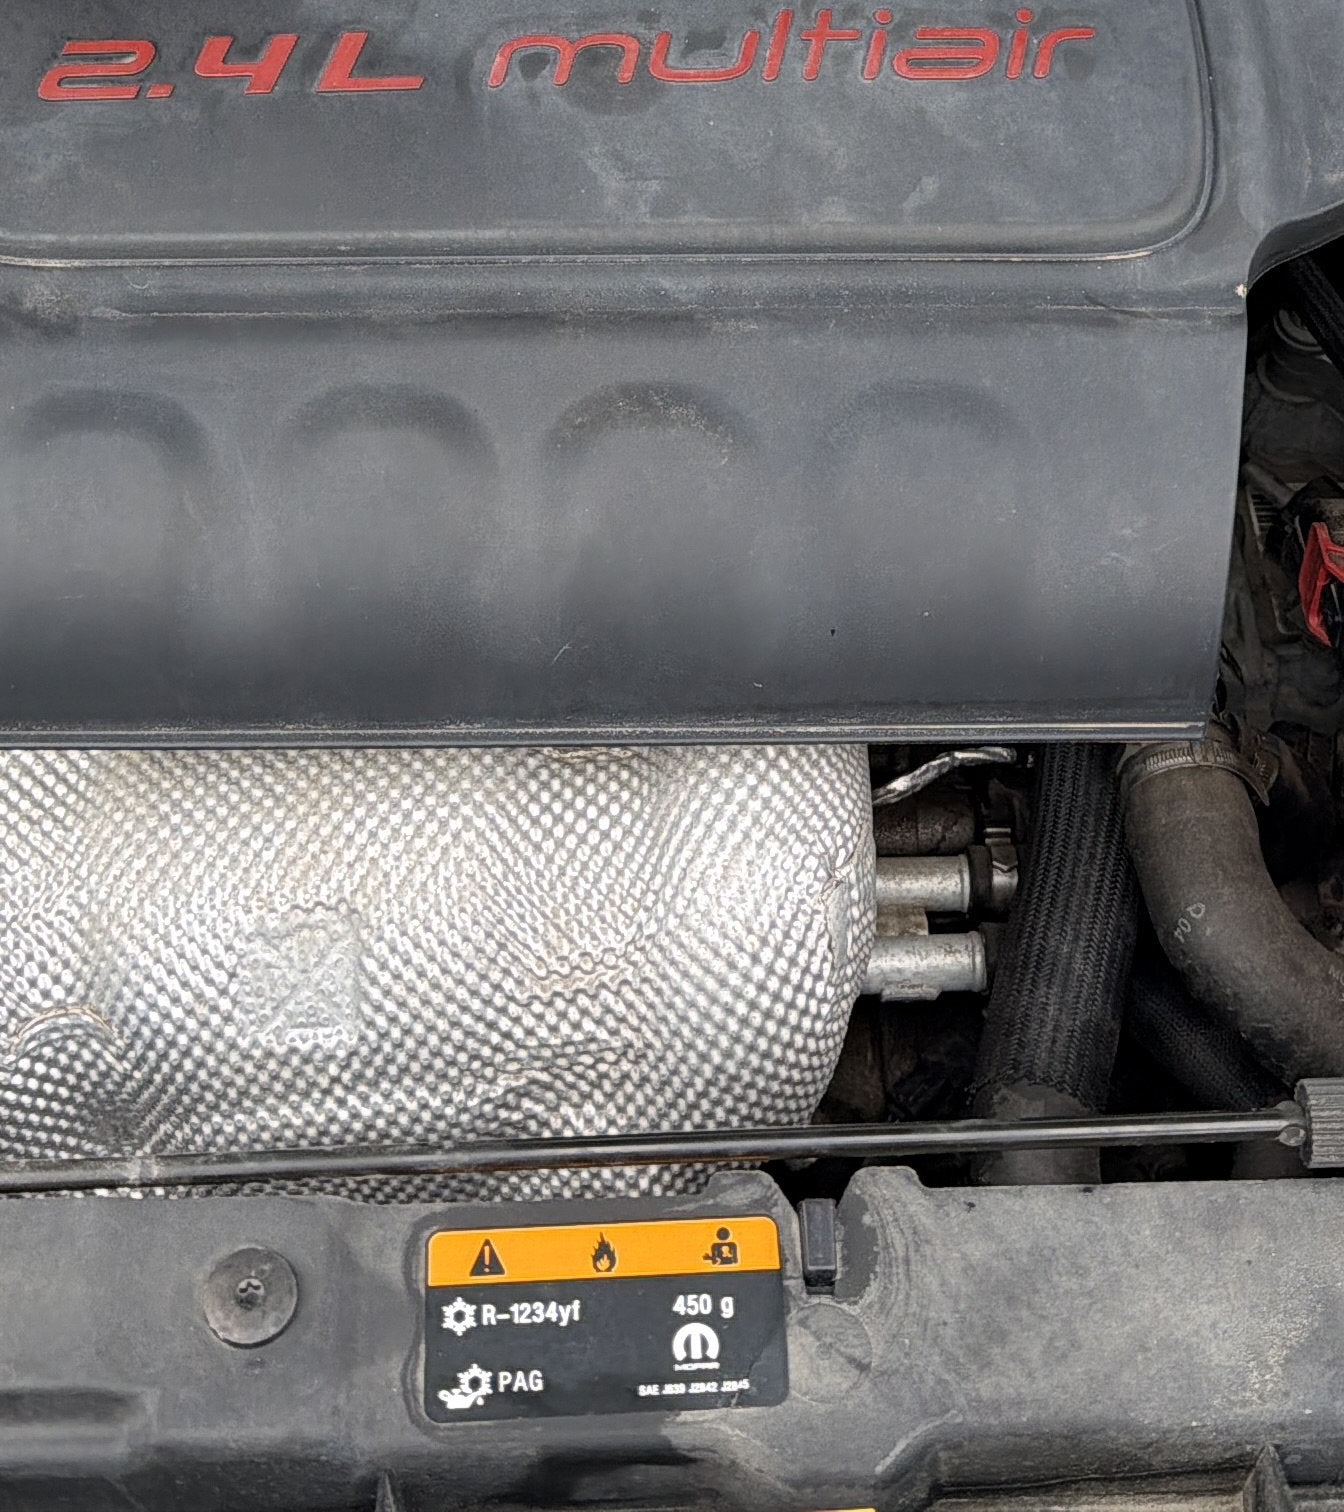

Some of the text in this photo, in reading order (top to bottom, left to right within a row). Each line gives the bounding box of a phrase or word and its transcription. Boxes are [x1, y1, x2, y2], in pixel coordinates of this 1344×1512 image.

[37, 7, 1096, 102] 2.4L multiair
[481, 1294, 734, 1328] R-1234yf 450 g
[498, 1370, 544, 1394] PAG
[638, 1384, 660, 1396] SAE
[688, 1382, 718, 1394] J2842
[720, 1378, 750, 1392] J2845
